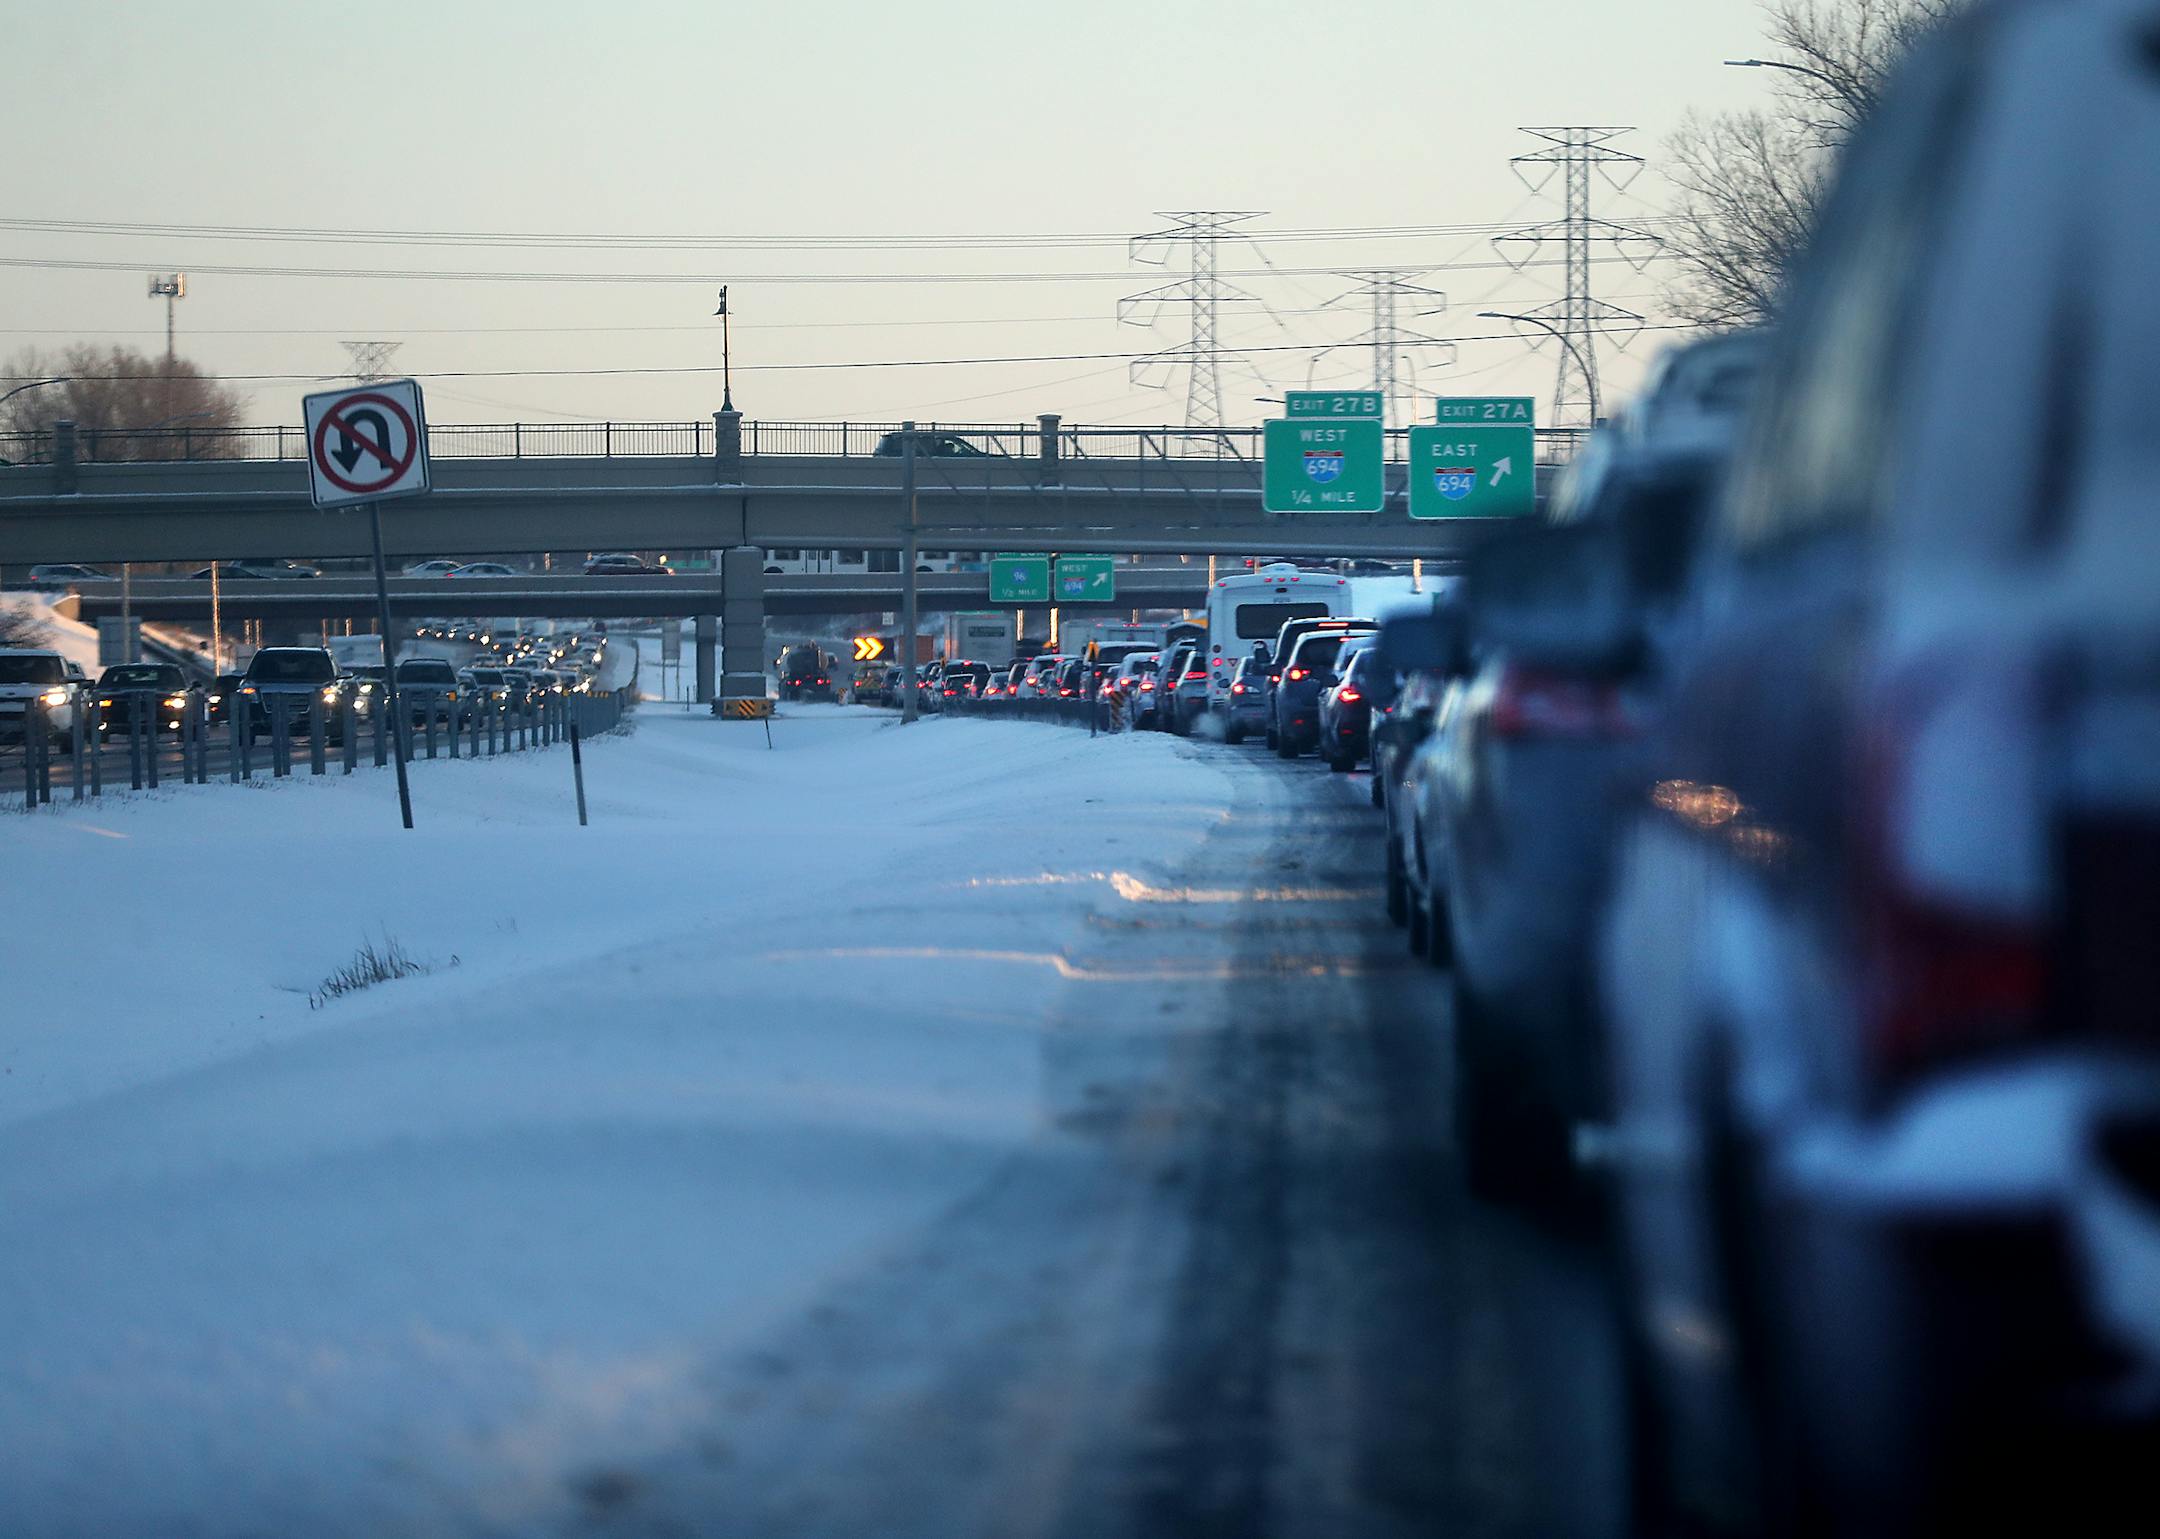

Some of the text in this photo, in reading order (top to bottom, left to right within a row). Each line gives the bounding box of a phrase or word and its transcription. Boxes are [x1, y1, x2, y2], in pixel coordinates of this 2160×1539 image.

[1292, 397, 1377, 413] EXIT 27B
[1443, 403, 1528, 419] EXIT 27A
[1300, 429, 1348, 442] WEST
[1431, 444, 1478, 457] EAST
[1306, 459, 1339, 475] 694
[1439, 476, 1471, 492] 694
[1321, 491, 1356, 503] MILE
[1062, 564, 1087, 573] WEST
